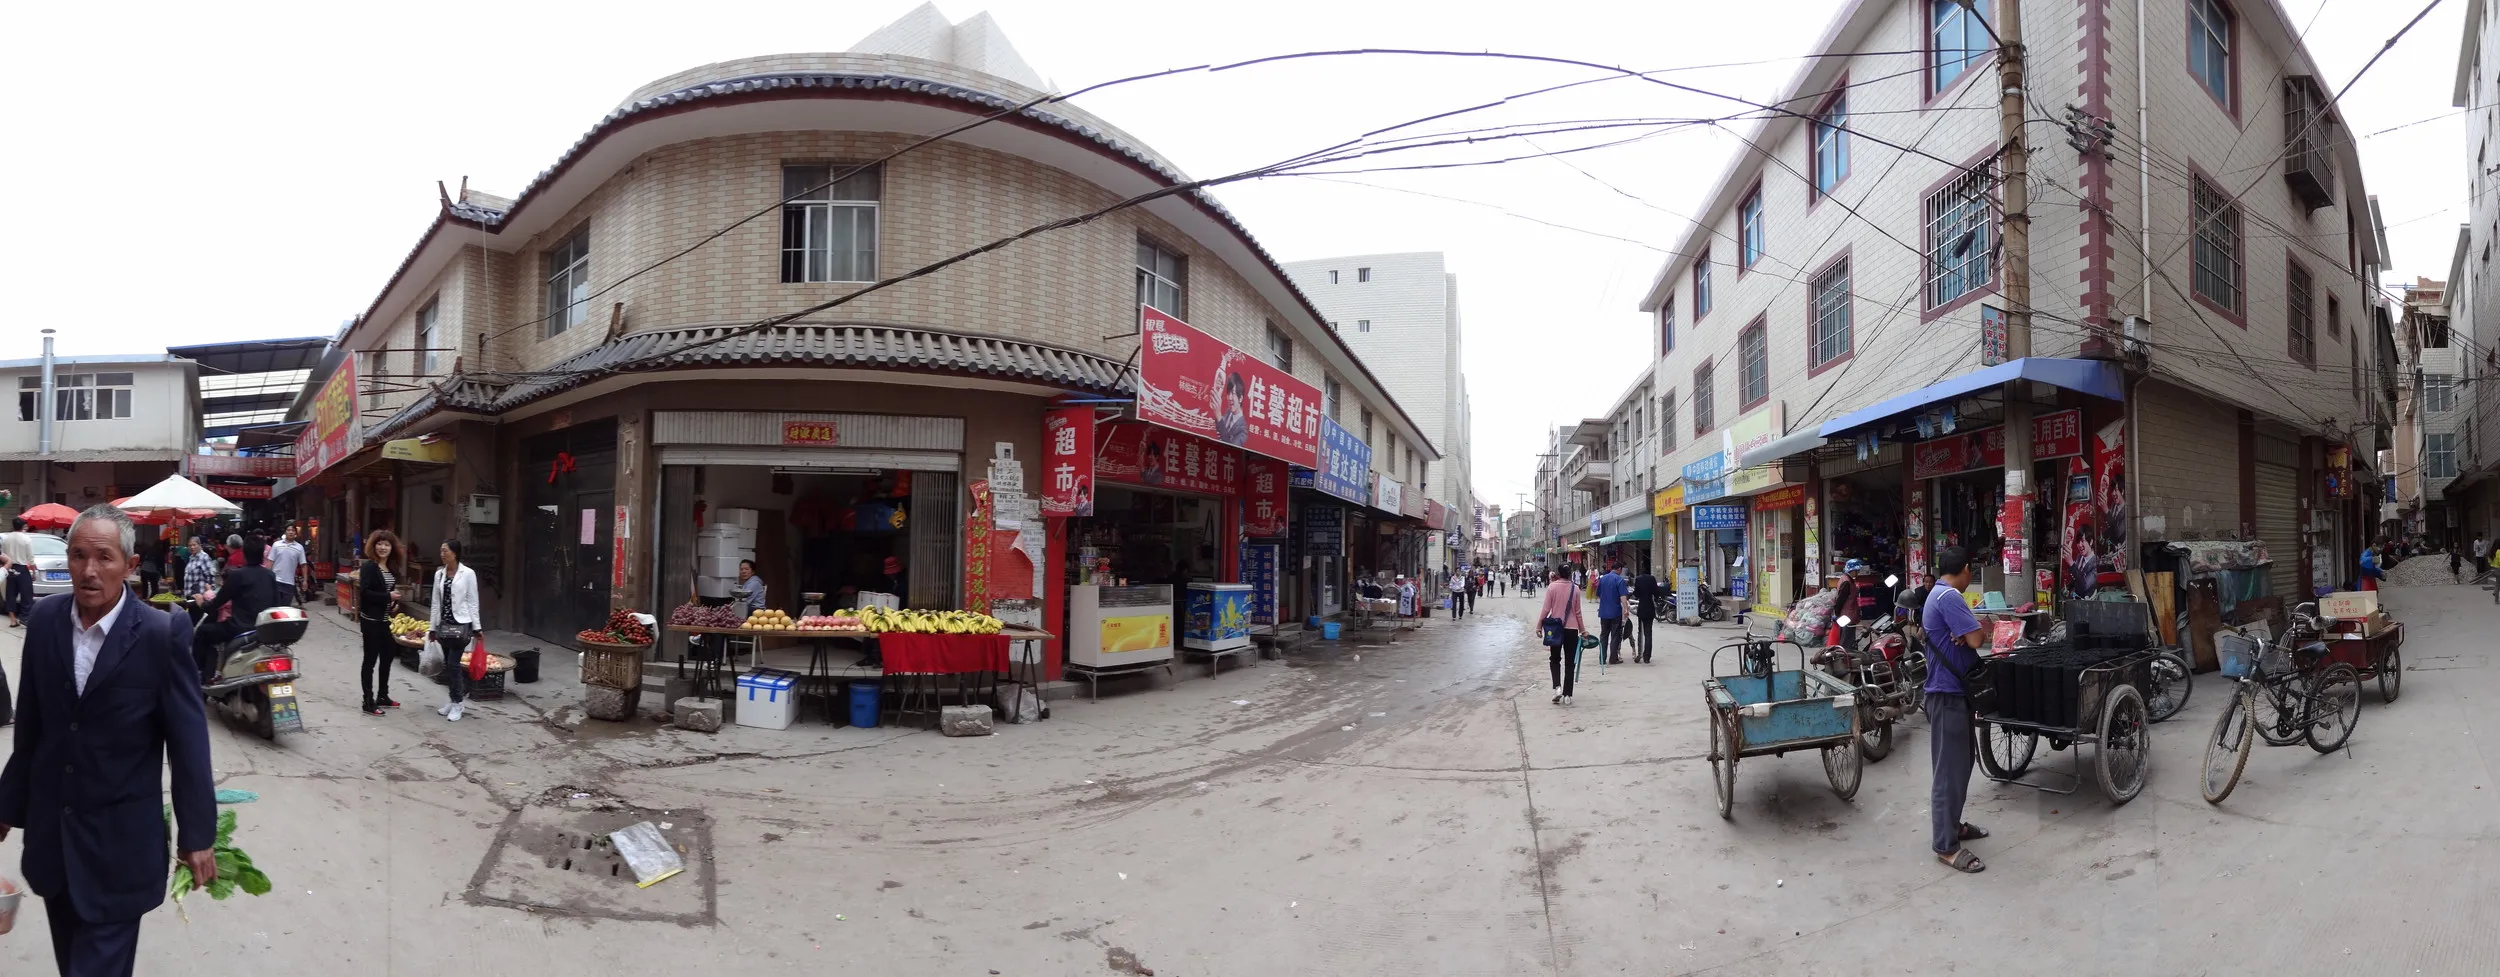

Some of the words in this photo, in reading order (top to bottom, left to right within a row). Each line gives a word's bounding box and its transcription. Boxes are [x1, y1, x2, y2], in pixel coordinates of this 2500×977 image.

[1986, 319, 1994, 359] 平安入户
[1247, 374, 1319, 439] 佳馨超市
[1054, 426, 1077, 492] 超市
[1163, 436, 1236, 484] 佳馨超市
[1255, 473, 1274, 520] 超市
